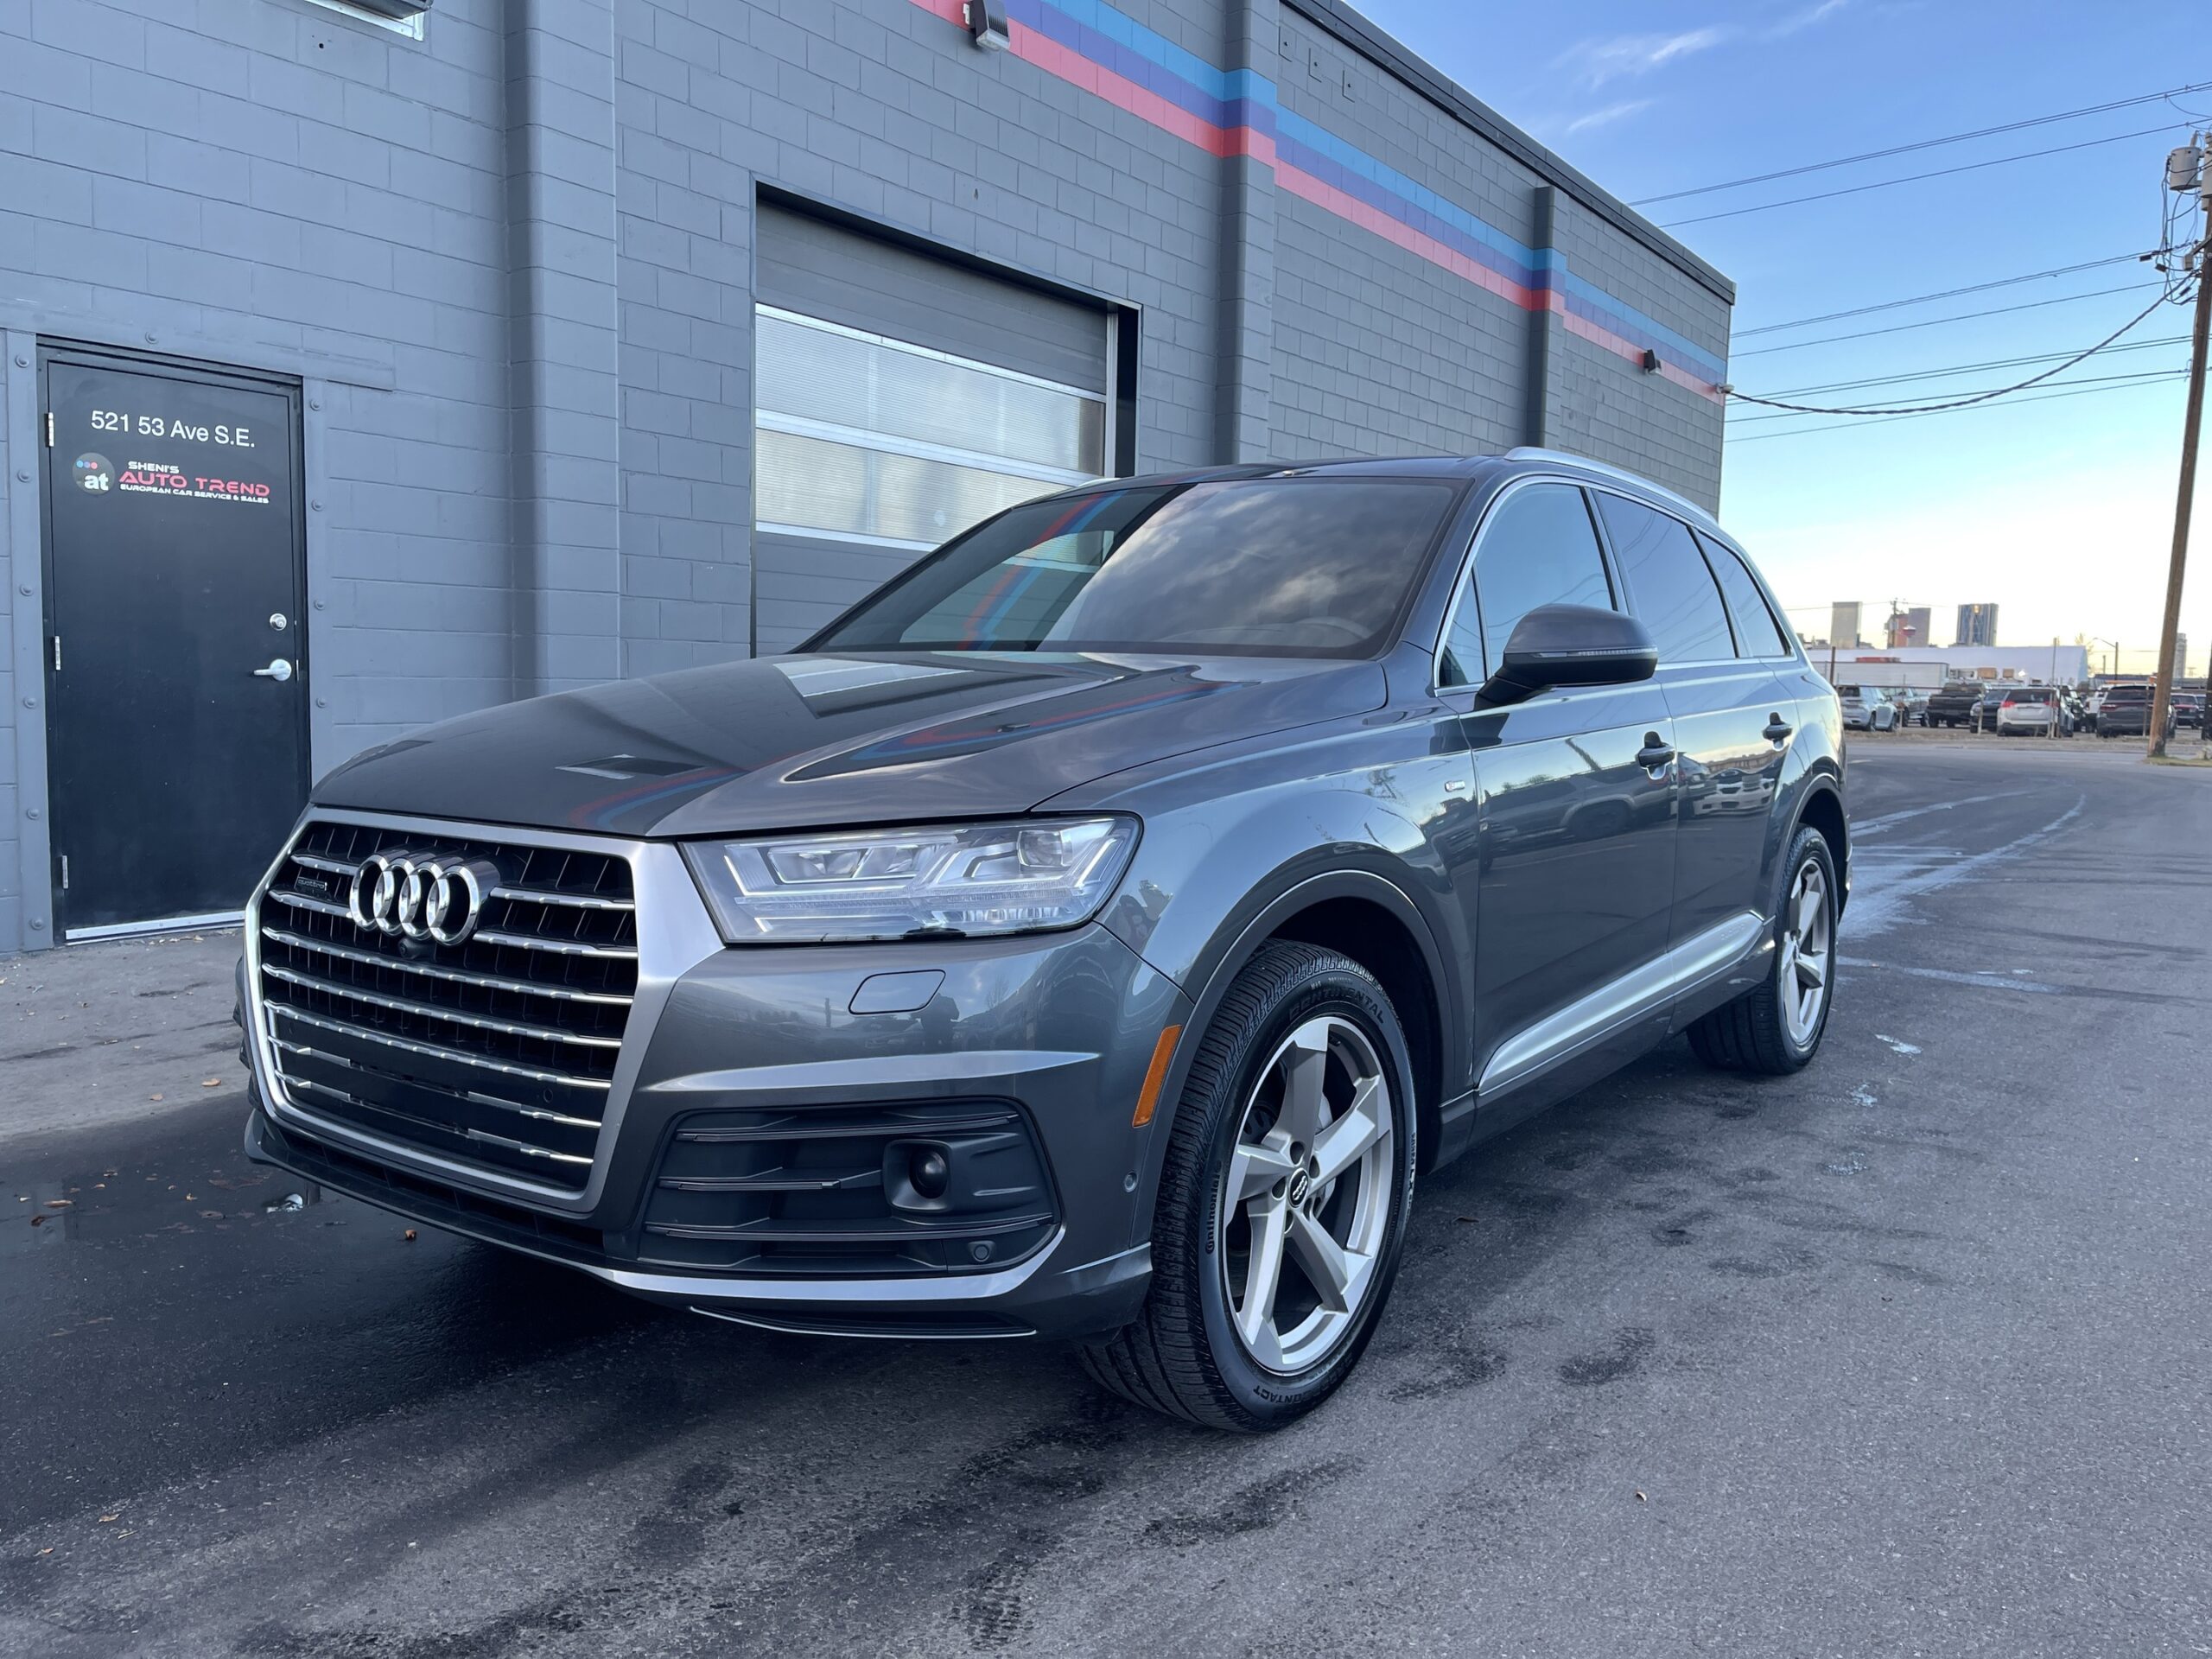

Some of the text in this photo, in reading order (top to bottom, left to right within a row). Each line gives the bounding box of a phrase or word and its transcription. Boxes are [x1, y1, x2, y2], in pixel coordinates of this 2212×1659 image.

[91, 410, 255, 448] 521 53 Ave S.E.
[128, 461, 180, 474] SHENI'S
[84, 473, 109, 491] at
[119, 471, 270, 497] AUTO TREND
[120, 483, 171, 494] EUROPEAN
[172, 488, 193, 497] CAR
[194, 490, 232, 500] SERVICE
[240, 495, 270, 504] SALES
